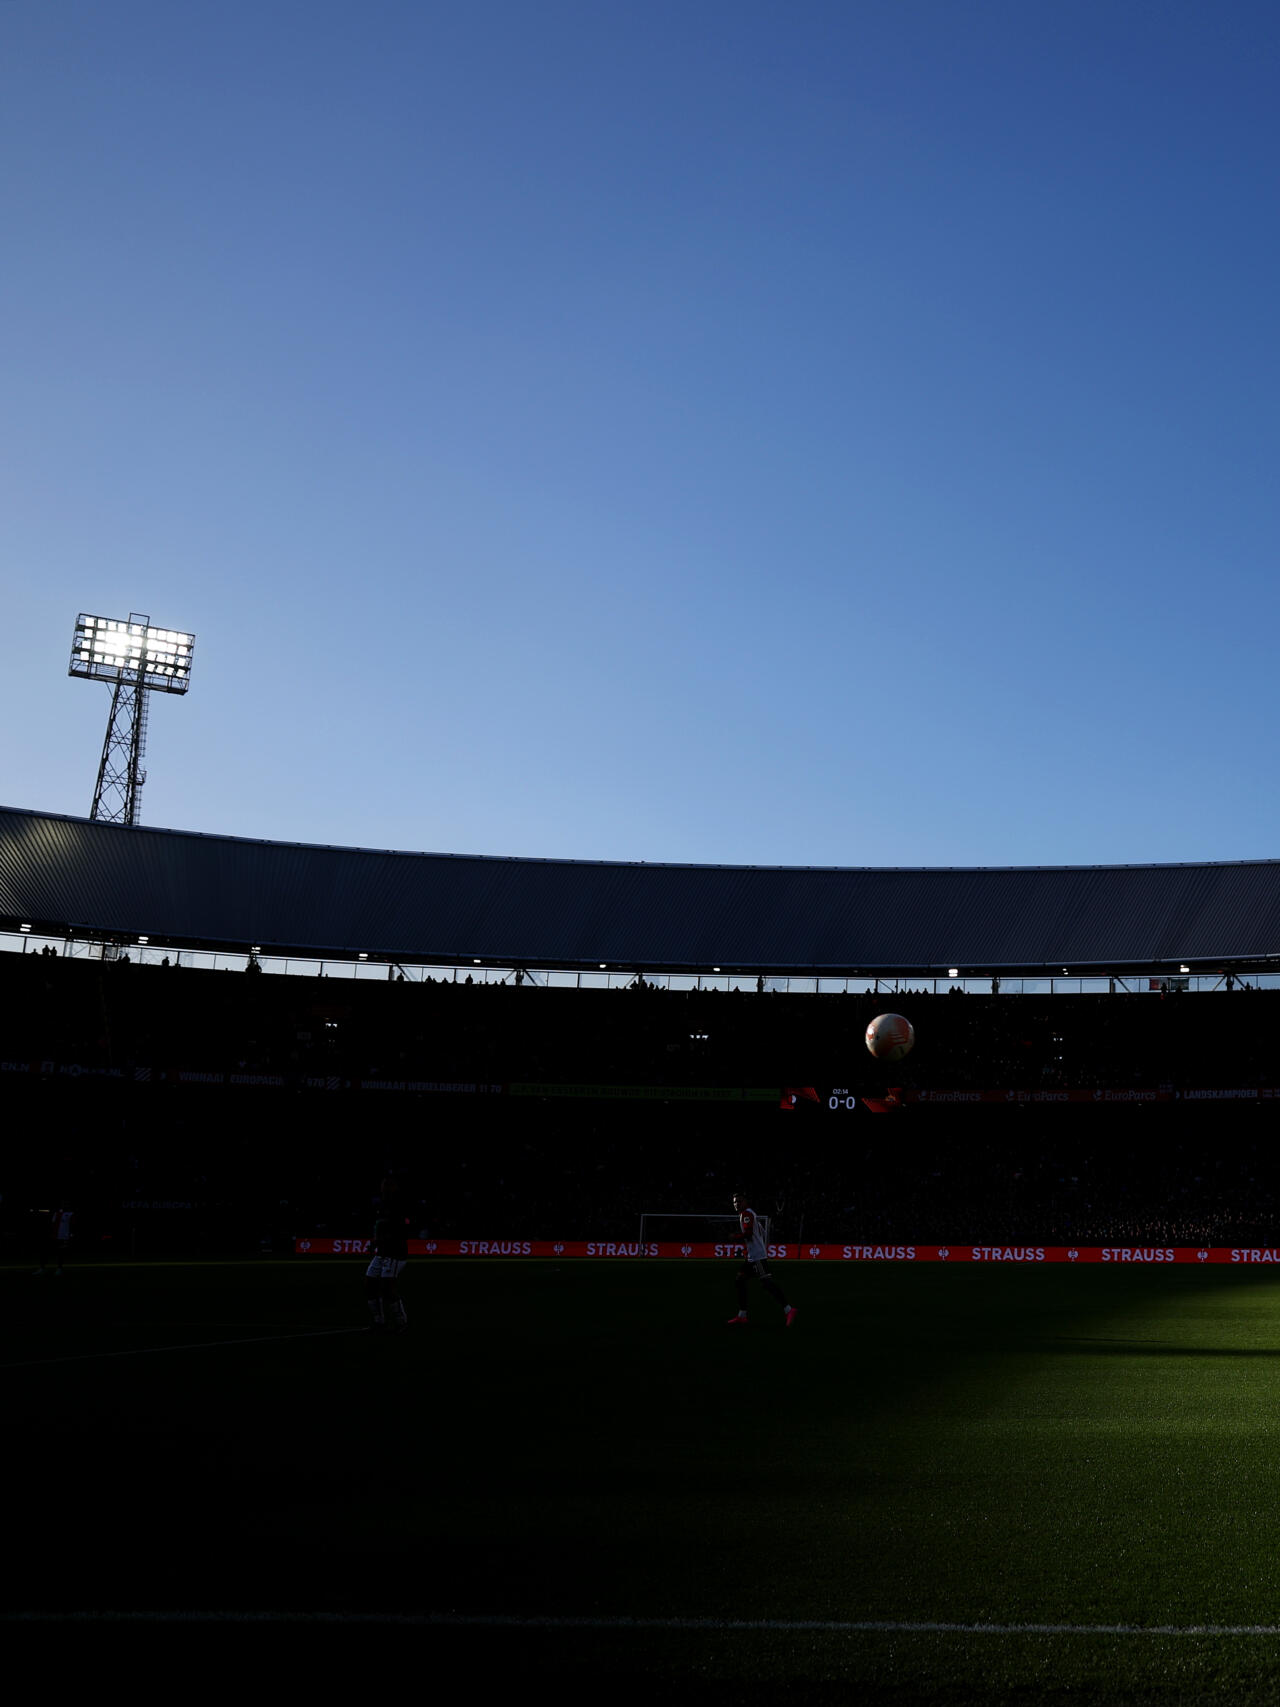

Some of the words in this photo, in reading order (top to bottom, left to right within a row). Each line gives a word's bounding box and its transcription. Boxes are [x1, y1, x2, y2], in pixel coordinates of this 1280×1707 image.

[828, 1096, 856, 1110] 0-0
[333, 1240, 378, 1255] STRA
[459, 1241, 532, 1256] STRAUSS
[586, 1242, 660, 1257] STRAUSS
[714, 1243, 788, 1258] STRSS
[842, 1245, 917, 1260] STRAUSS
[971, 1247, 1046, 1262] STRAUSS
[1100, 1248, 1175, 1262] STRAUSS
